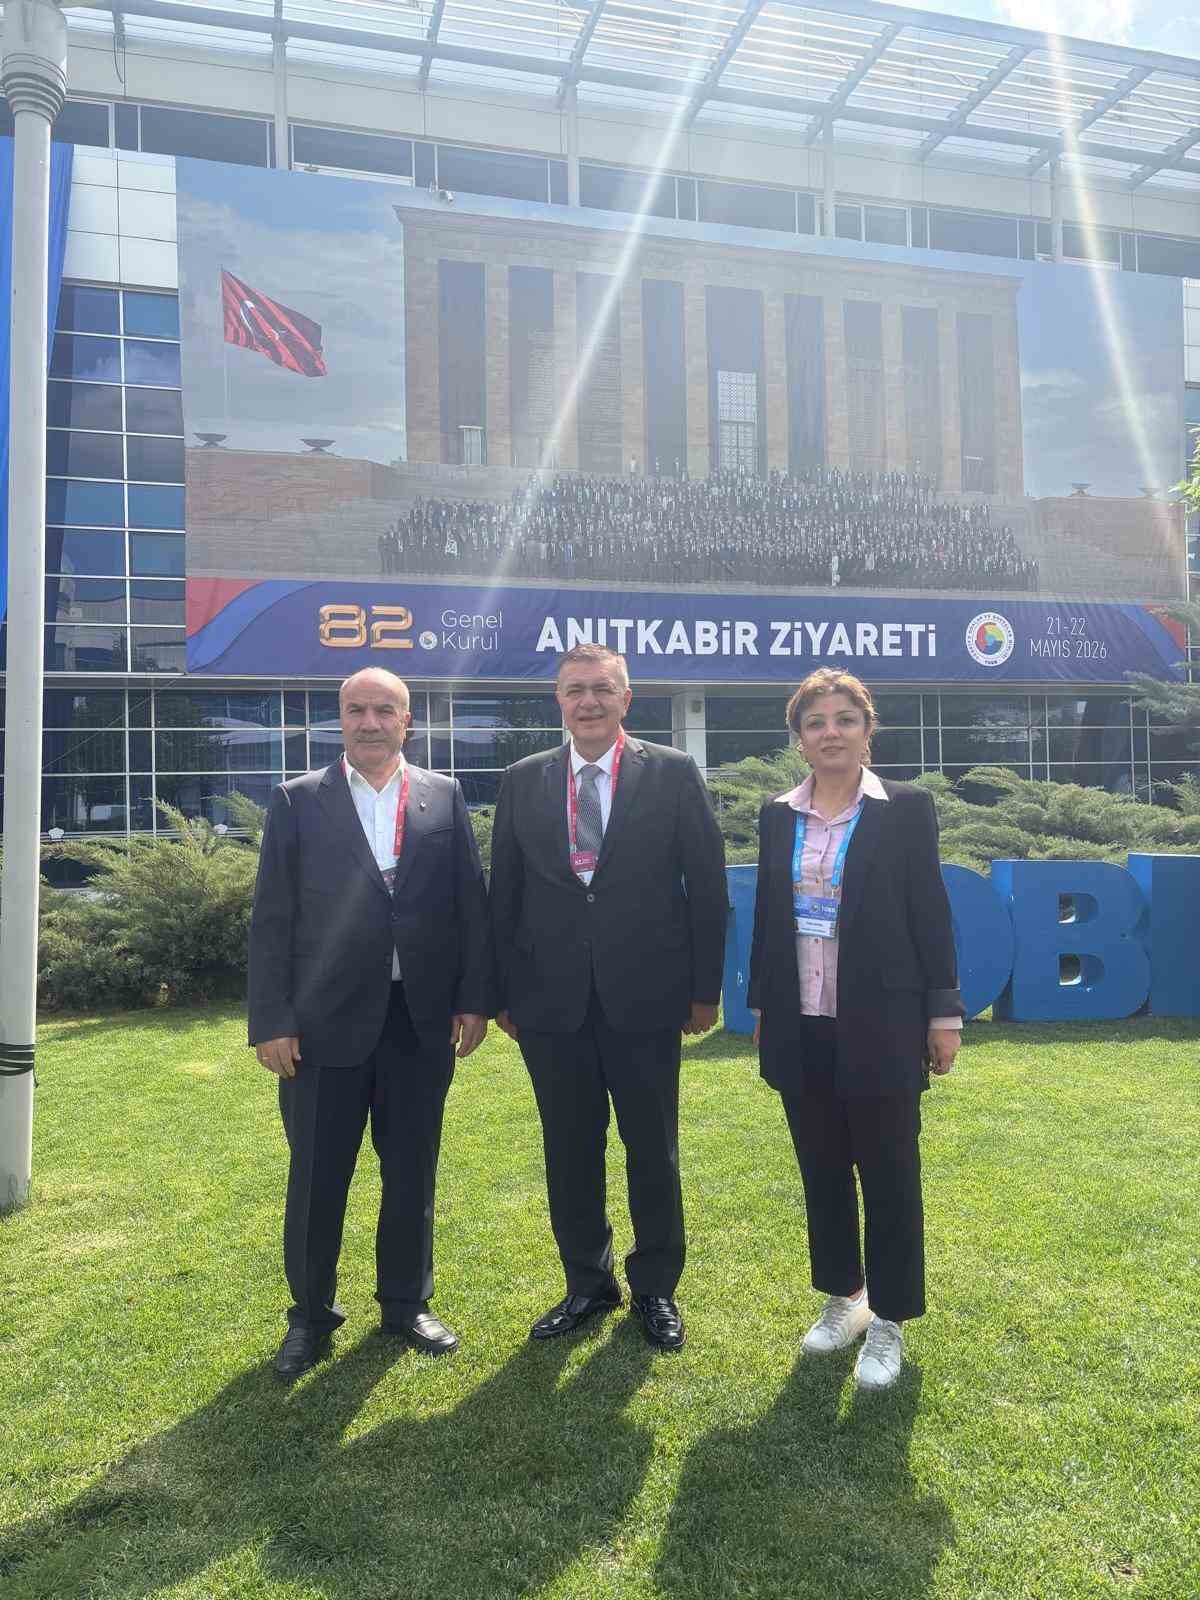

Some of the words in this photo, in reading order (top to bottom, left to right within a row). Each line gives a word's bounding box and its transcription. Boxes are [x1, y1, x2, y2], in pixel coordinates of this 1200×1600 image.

[441, 609, 502, 629] Genel
[1046, 616, 1086, 636] 21-22
[442, 631, 498, 650] Kurul
[1030, 638, 1071, 658] MAYIS
[1075, 640, 1107, 659] 2026
